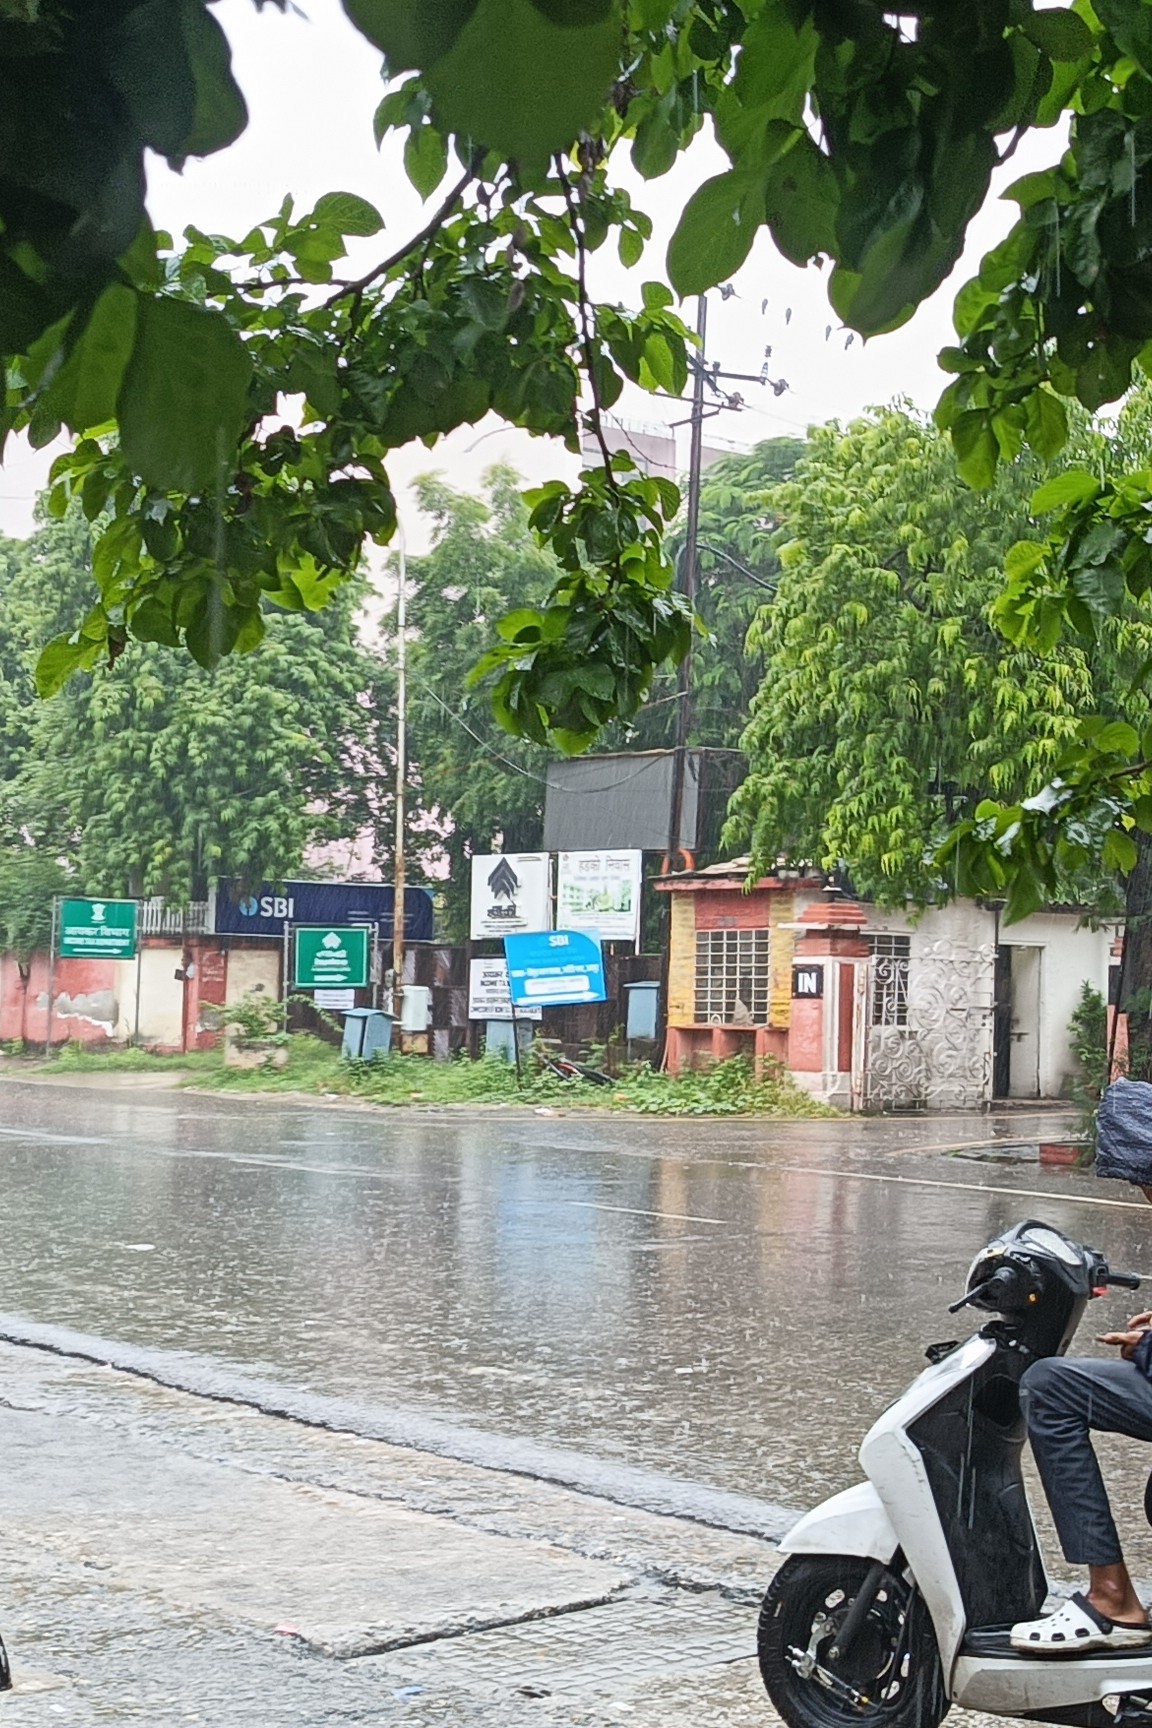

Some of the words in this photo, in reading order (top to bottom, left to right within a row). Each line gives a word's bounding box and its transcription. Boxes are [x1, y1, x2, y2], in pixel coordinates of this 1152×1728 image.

[260, 897, 295, 919] SBI
[549, 935, 569, 947] SBI
[797, 972, 817, 993] IN
